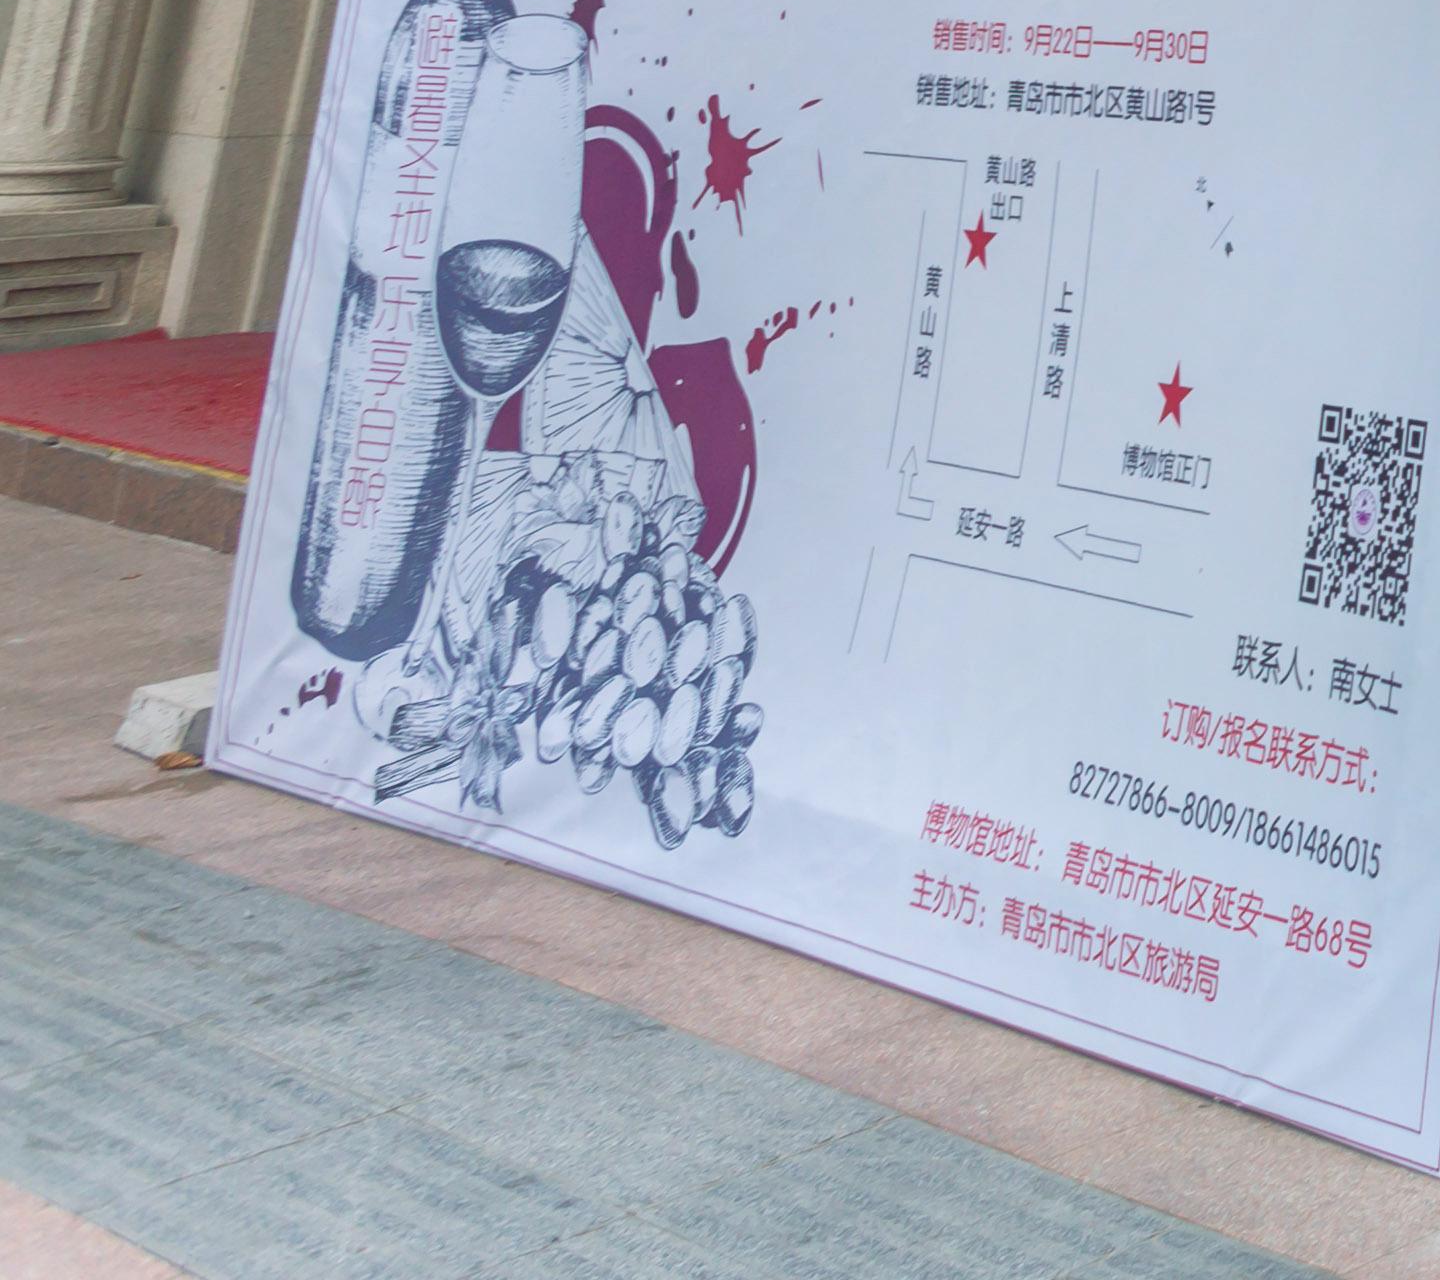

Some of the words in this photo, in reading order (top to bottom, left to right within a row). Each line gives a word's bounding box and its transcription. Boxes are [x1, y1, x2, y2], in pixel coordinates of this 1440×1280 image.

[984, 153, 1037, 188] 黄山路
[989, 191, 1024, 222] 出口
[912, 264, 943, 379] 黄山路
[1120, 440, 1213, 490] 博物馆正门
[955, 505, 1026, 549] 延安一路
